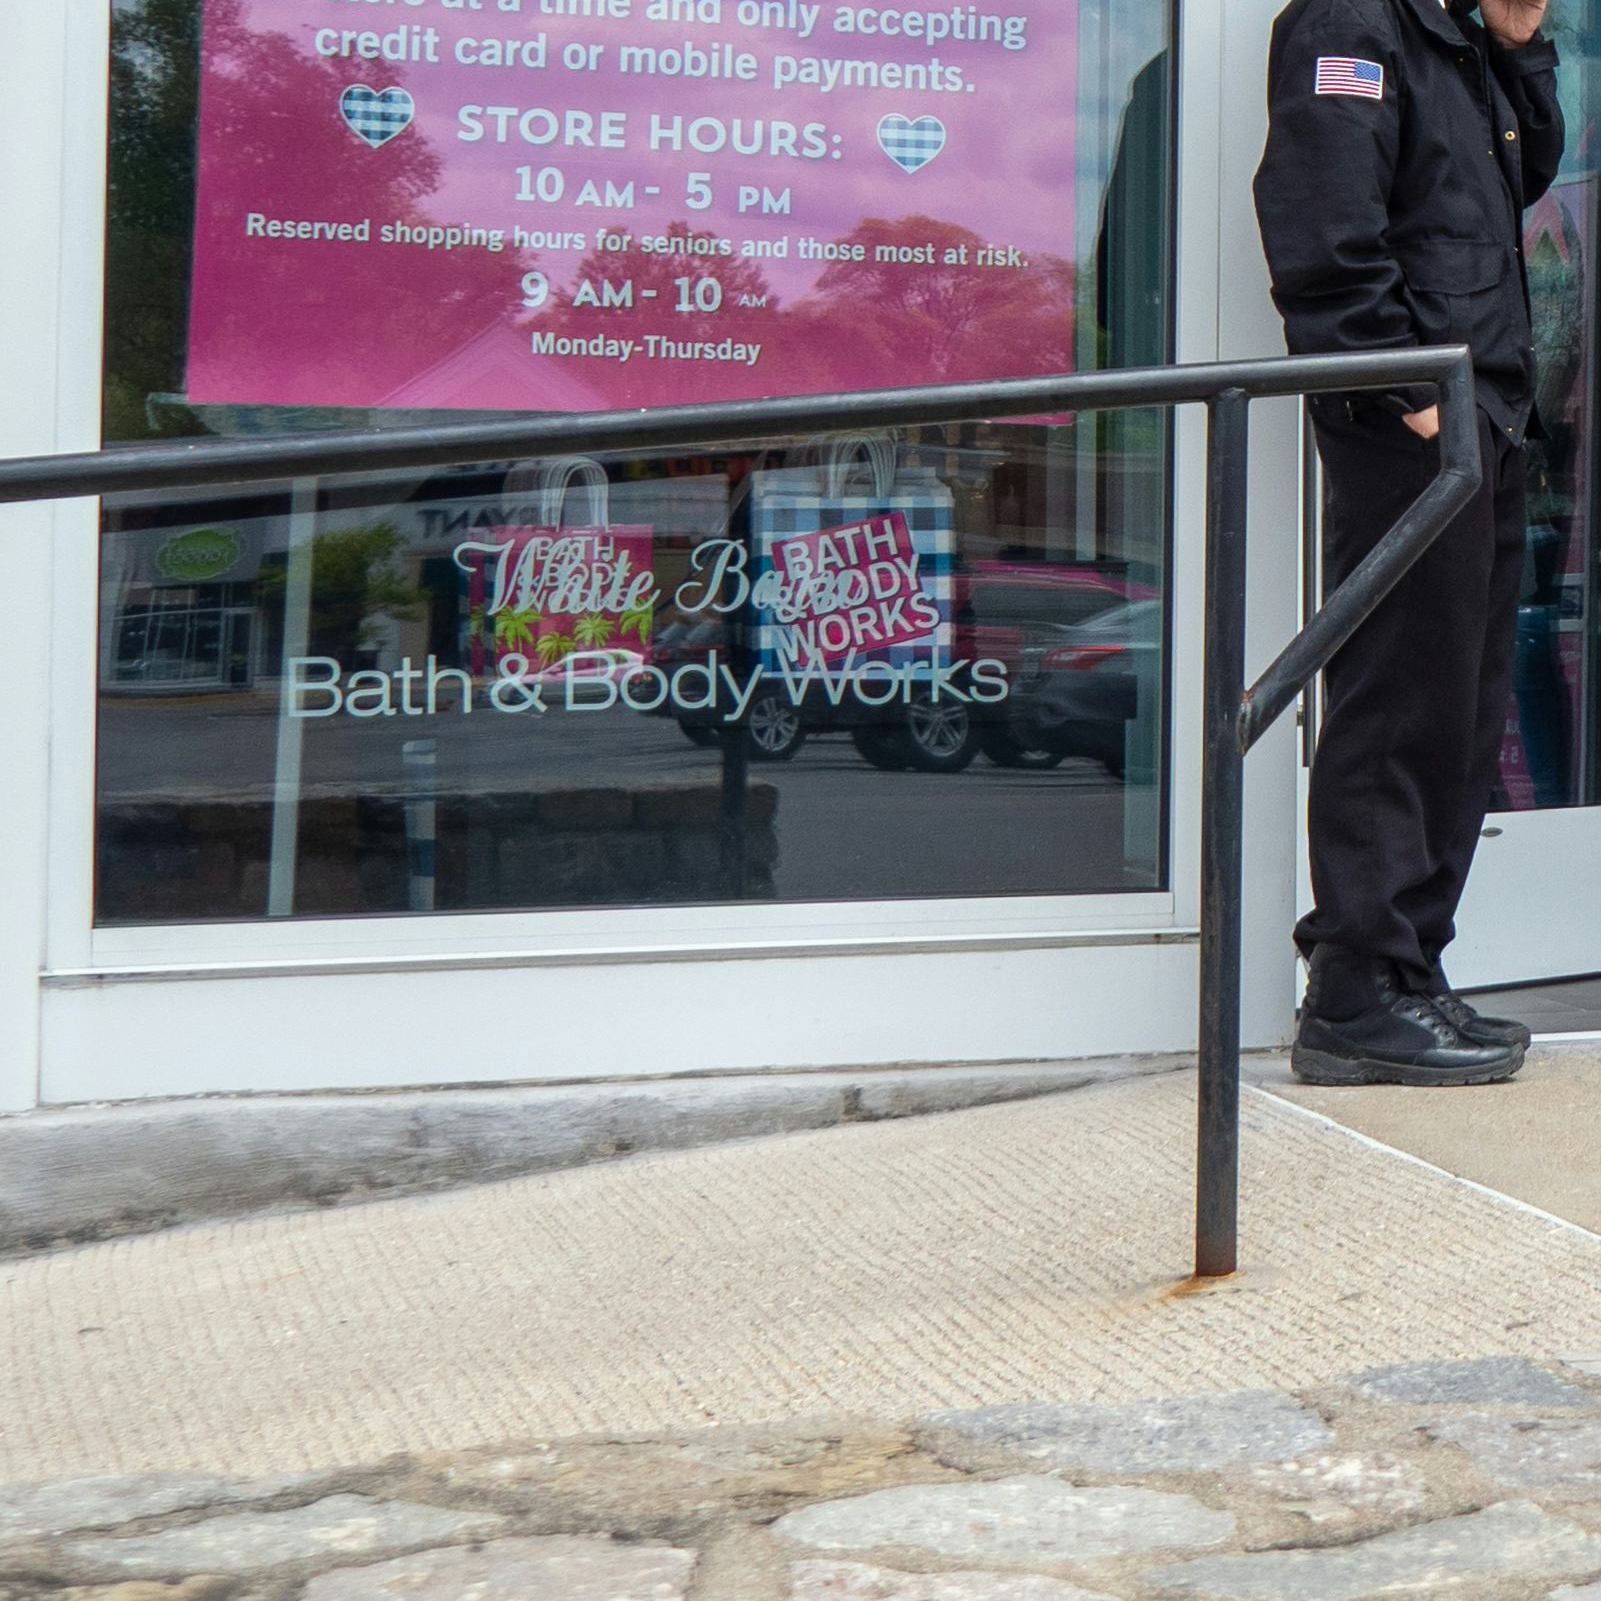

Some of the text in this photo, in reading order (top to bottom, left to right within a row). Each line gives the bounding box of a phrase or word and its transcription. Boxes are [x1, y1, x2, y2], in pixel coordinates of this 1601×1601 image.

[834, 6, 1026, 49] accepting
[316, 22, 974, 92] credit card or mobile payments.
[457, 105, 842, 158] STORE HOURS:
[516, 166, 790, 214] 10 AM 5 PM
[247, 213, 1028, 267] Reserved shopping hours for seniors and those most at risk.
[521, 271, 767, 312] 9 AM 10 AM
[532, 332, 761, 365] Monday-Thursday
[782, 518, 898, 580] BATH
[778, 592, 940, 662] WORKS
[289, 645, 1008, 722] Bath & Body Works
